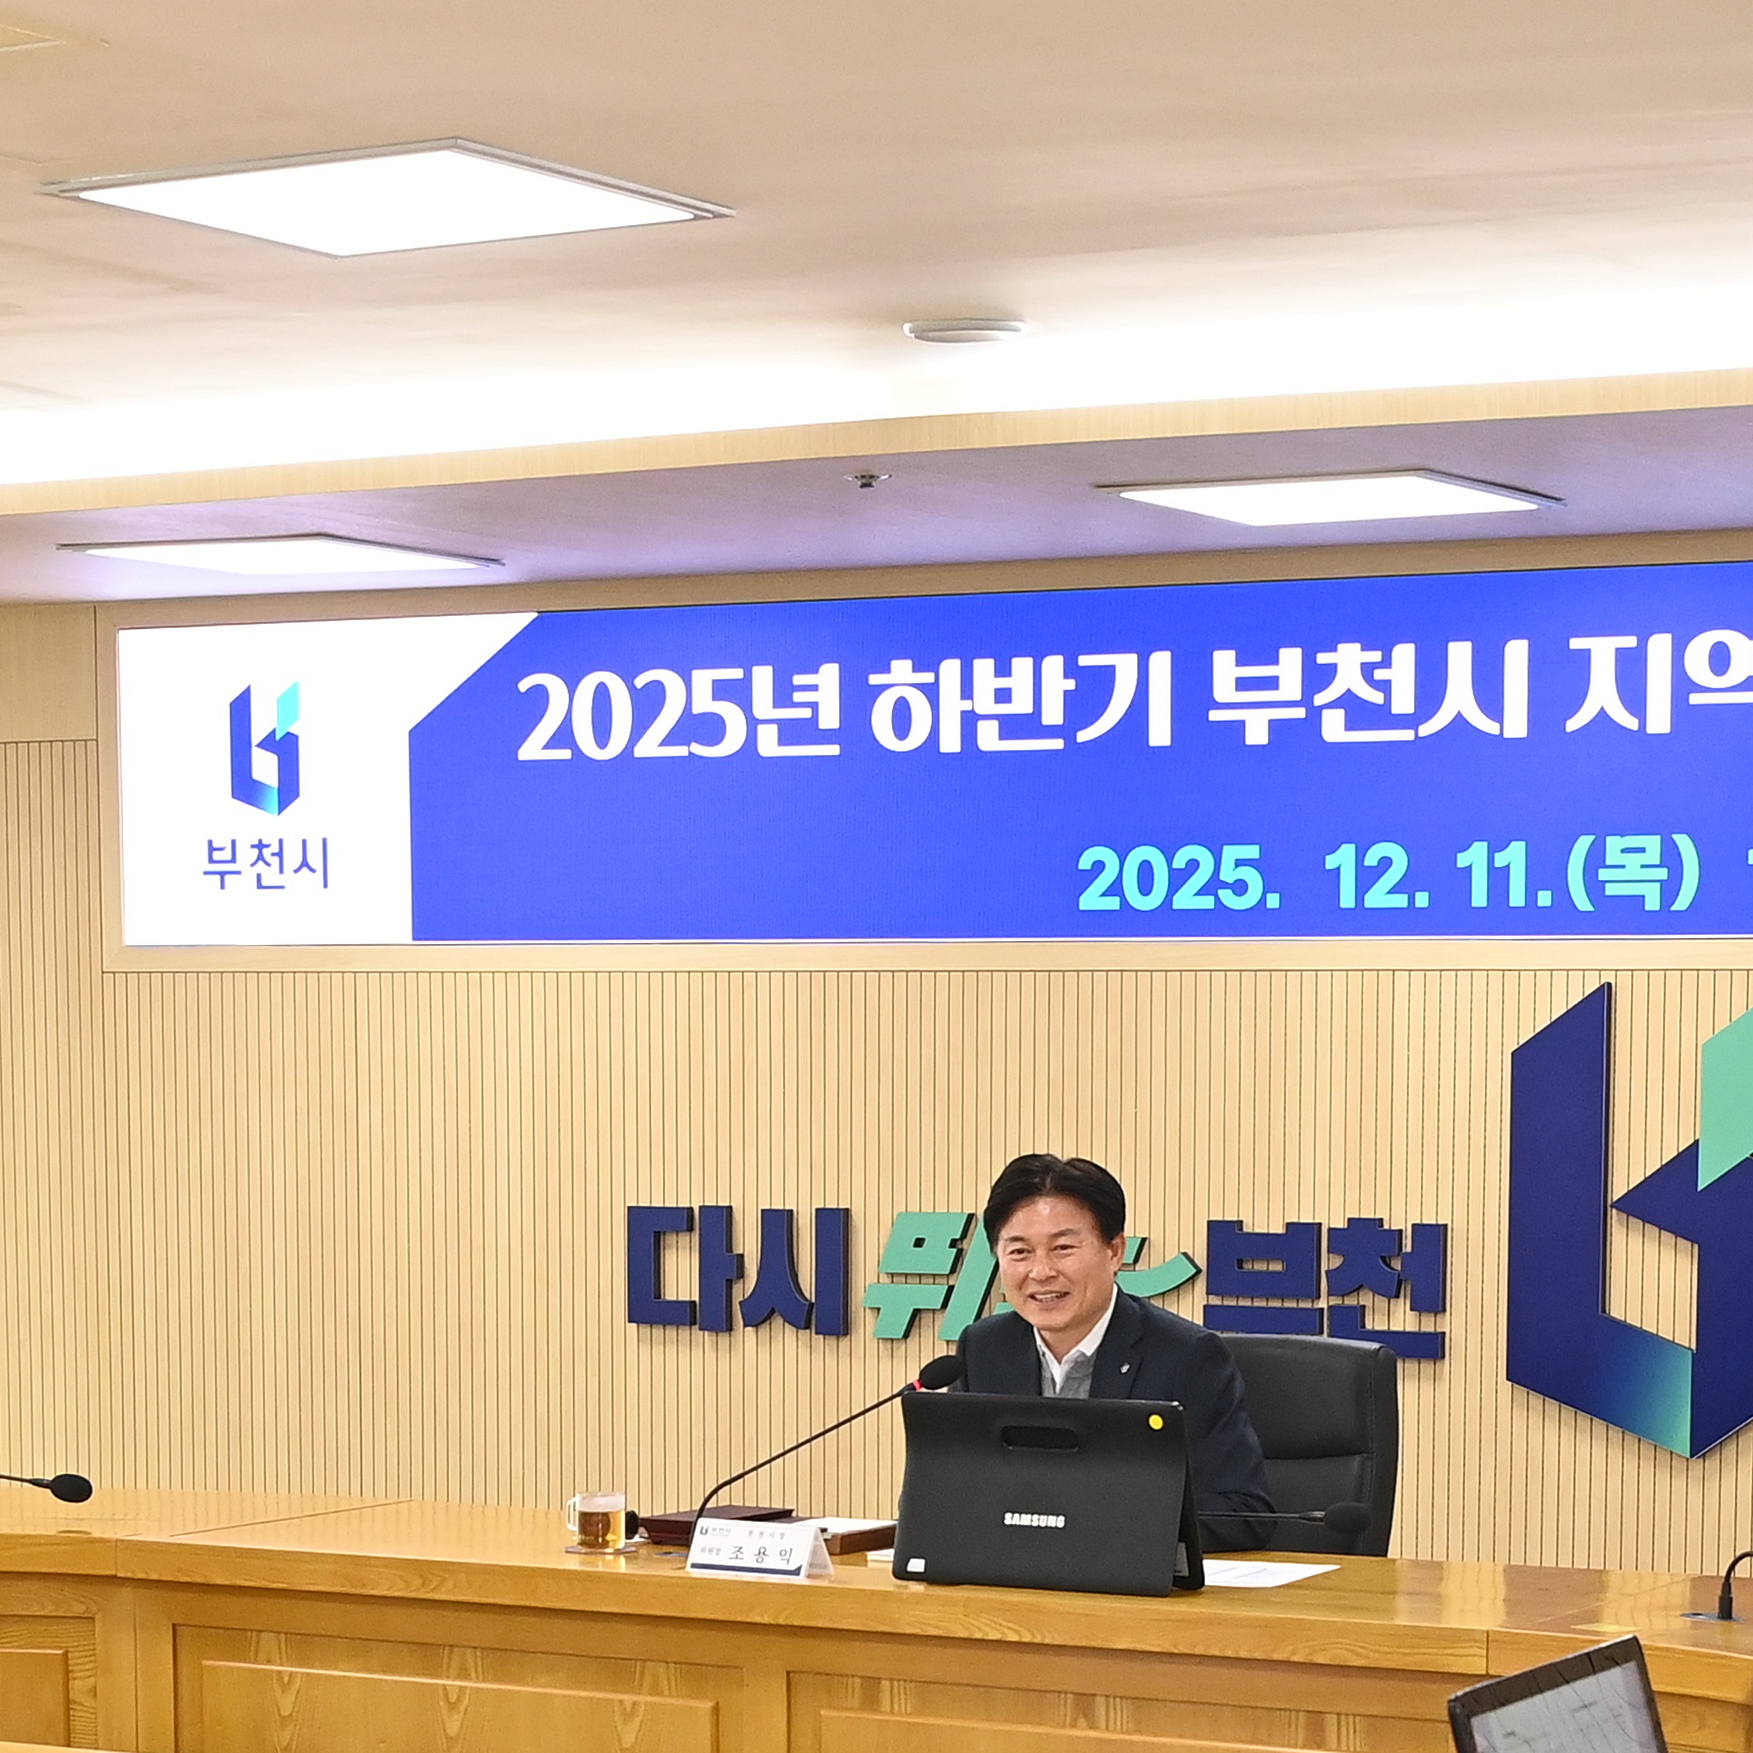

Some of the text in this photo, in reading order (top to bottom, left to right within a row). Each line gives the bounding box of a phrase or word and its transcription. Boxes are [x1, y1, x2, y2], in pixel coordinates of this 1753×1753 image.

[518, 663, 841, 761] 2025년
[868, 651, 1172, 753] 하반기
[1208, 640, 1529, 746] 부천시
[202, 837, 329, 890] 부천시
[1078, 845, 1280, 911] 2025.
[1324, 842, 1430, 909] 12.
[627, 1205, 850, 1336] 다시
[1203, 1217, 1448, 1360] 부천
[1003, 1512, 1066, 1529] SAMSUNG
